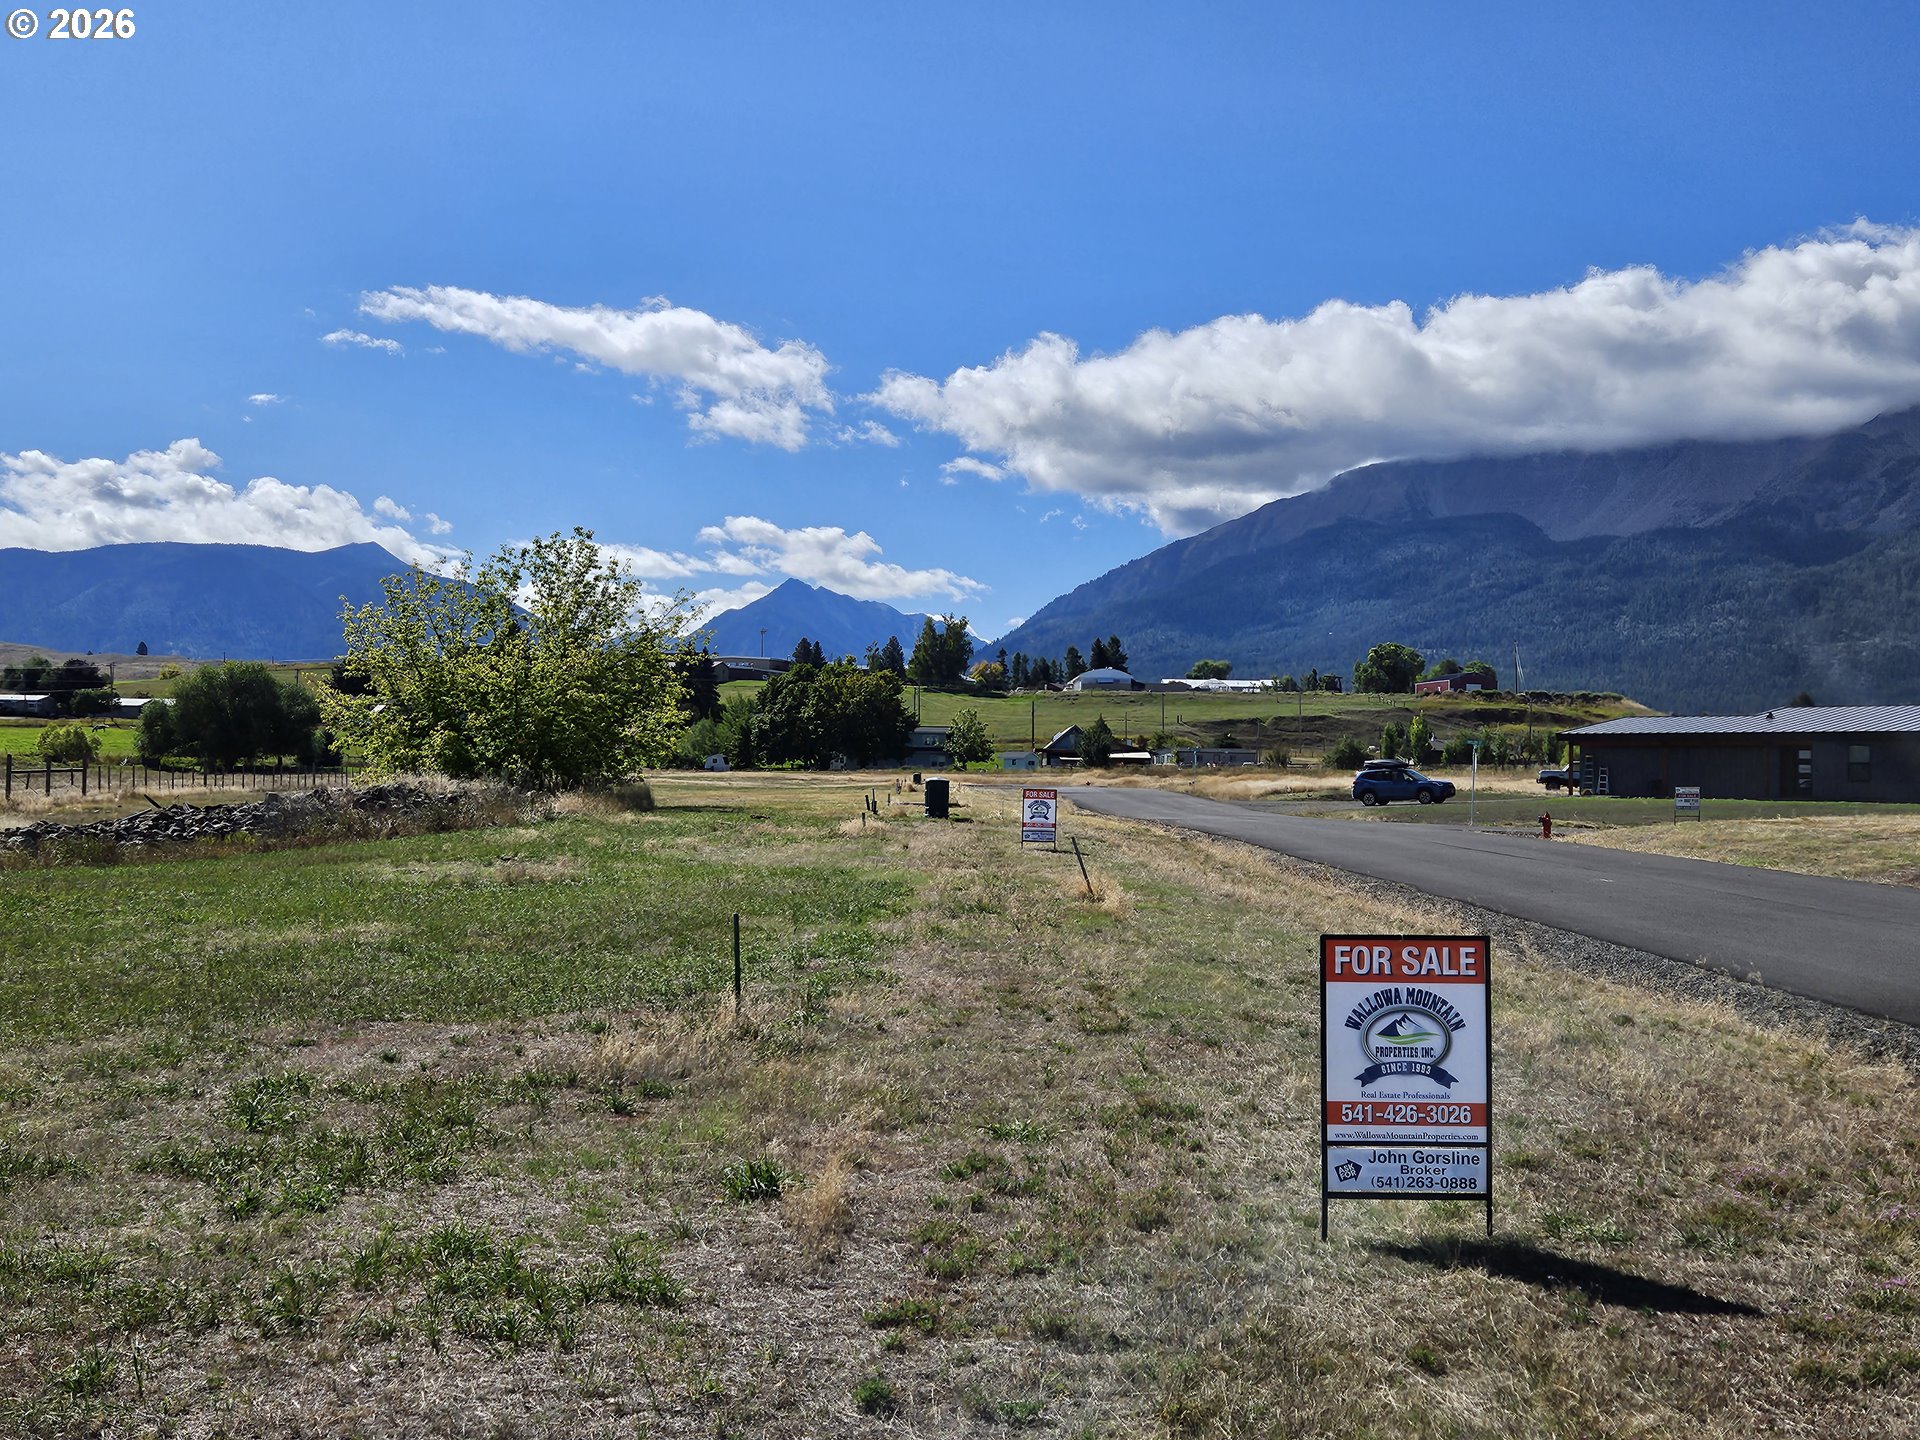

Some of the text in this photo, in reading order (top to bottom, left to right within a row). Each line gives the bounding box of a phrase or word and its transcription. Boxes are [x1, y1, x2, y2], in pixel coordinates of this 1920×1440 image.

[1334, 946, 1477, 976] FOR SALE
[1344, 987, 1466, 1033] WALLOWA MOUNTAIN
[1421, 1047, 1437, 1059] INC.
[1381, 1062, 1408, 1074] SINCE
[1361, 1091, 1451, 1100] Real Estate Professionals
[1341, 1104, 1472, 1124] 541-426-3026
[1334, 1131, 1479, 1142] www.WallowaMountainProperties.com
[1368, 1150, 1480, 1165] John Gorsline
[1338, 1163, 1355, 1174] ASK
[1400, 1165, 1447, 1175] Broker
[1340, 1170, 1357, 1180] FOR
[1371, 1176, 1478, 1190] (541)263-0888
